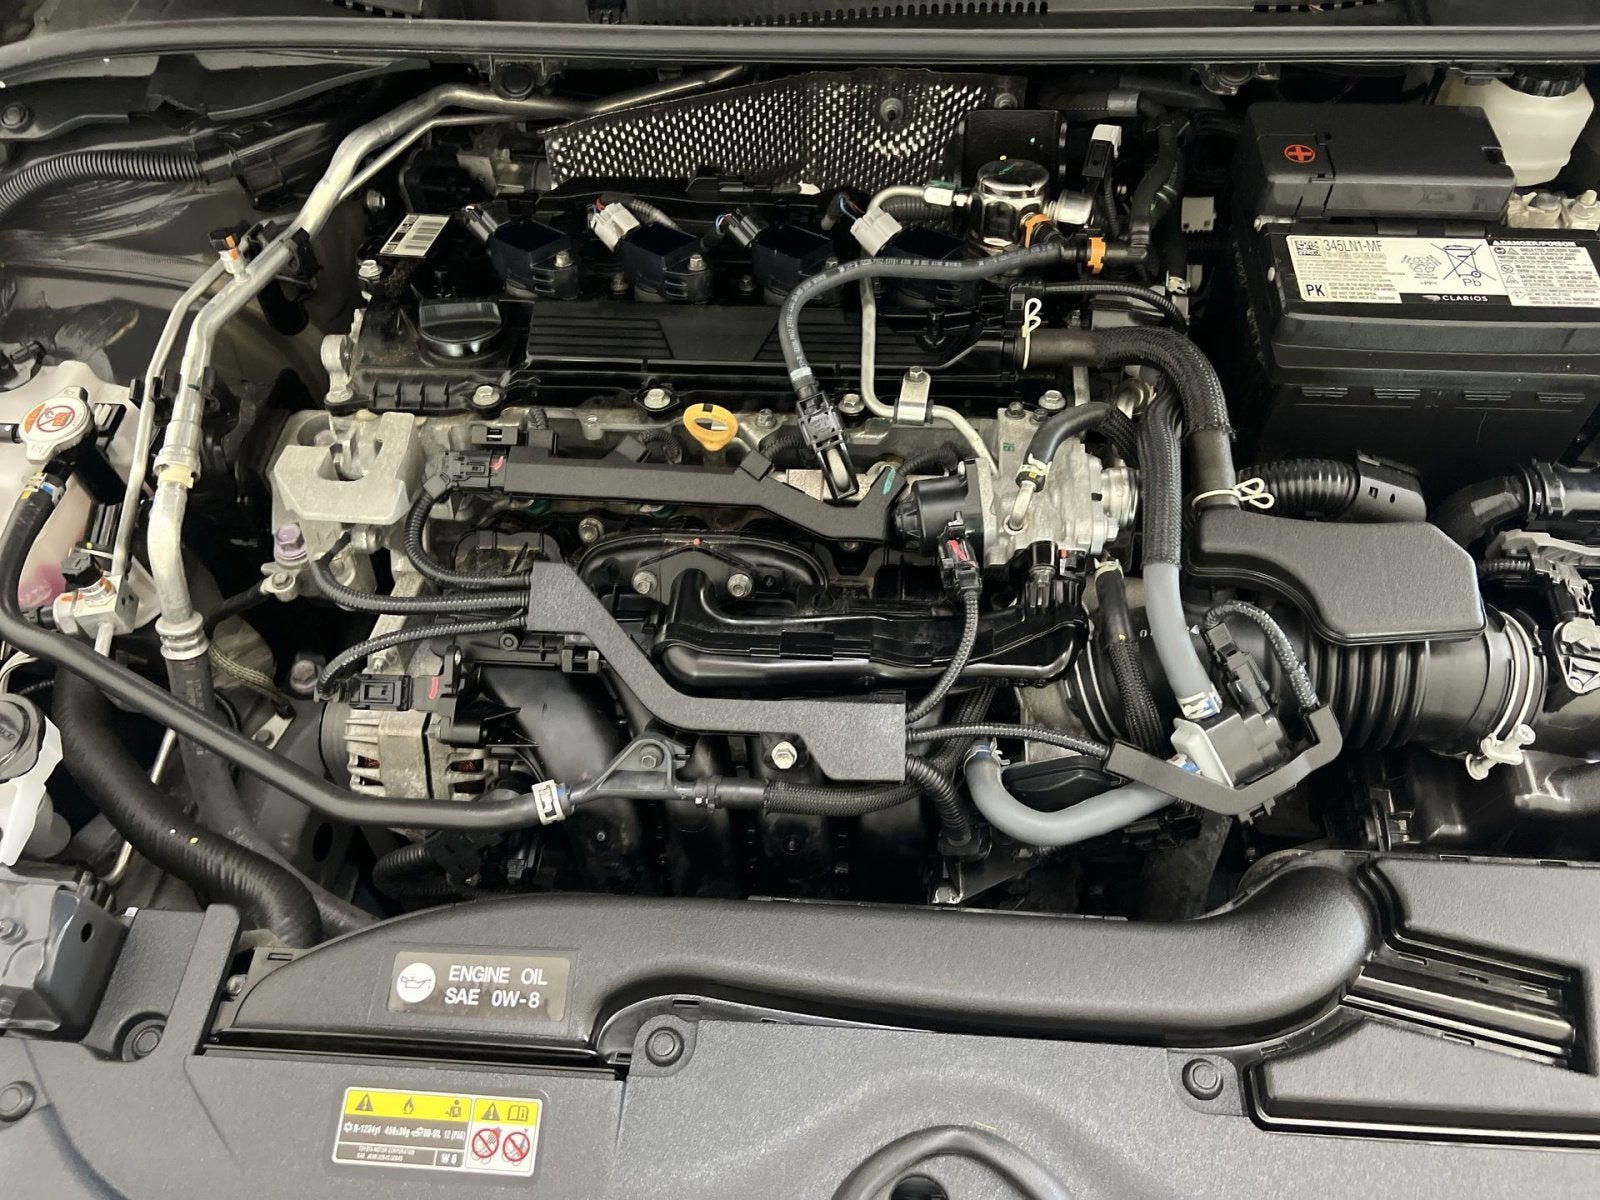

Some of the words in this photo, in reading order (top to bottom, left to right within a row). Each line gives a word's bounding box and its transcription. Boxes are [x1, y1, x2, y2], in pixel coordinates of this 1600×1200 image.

[1323, 239, 1383, 253] 345LN1-MF
[1462, 278, 1482, 287] Pb
[1305, 283, 1326, 297] PK
[1442, 294, 1488, 302] CLARIOS
[448, 964, 511, 984] ENGINE
[520, 967, 548, 985] OIL
[444, 987, 480, 1005] SAE
[491, 989, 540, 1009] 0W-8
[441, 1153, 449, 1164] W
